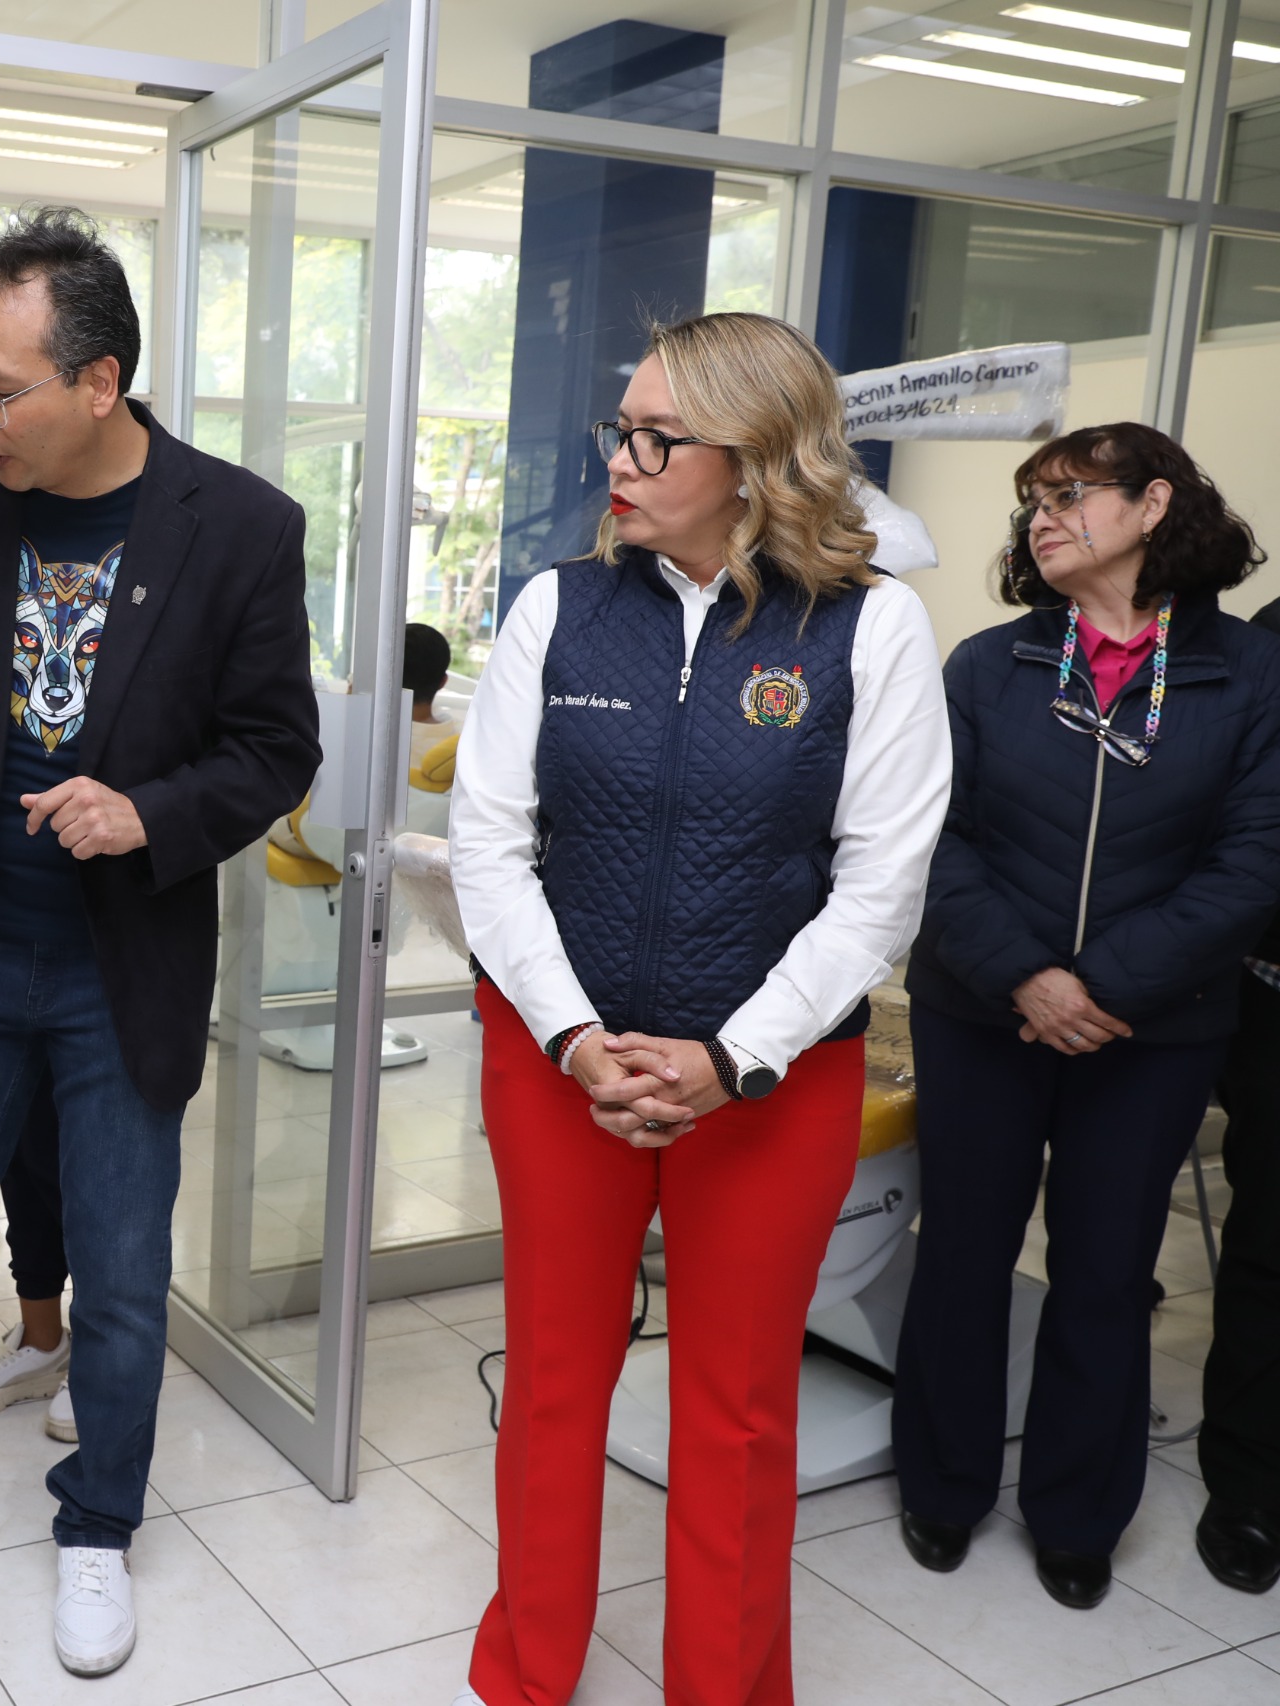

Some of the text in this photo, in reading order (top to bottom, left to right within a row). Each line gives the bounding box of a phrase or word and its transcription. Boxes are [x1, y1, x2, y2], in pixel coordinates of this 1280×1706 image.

[549, 695, 563, 706] Dra.
[565, 694, 589, 706] Yarabí
[588, 693, 608, 708] Ávila
